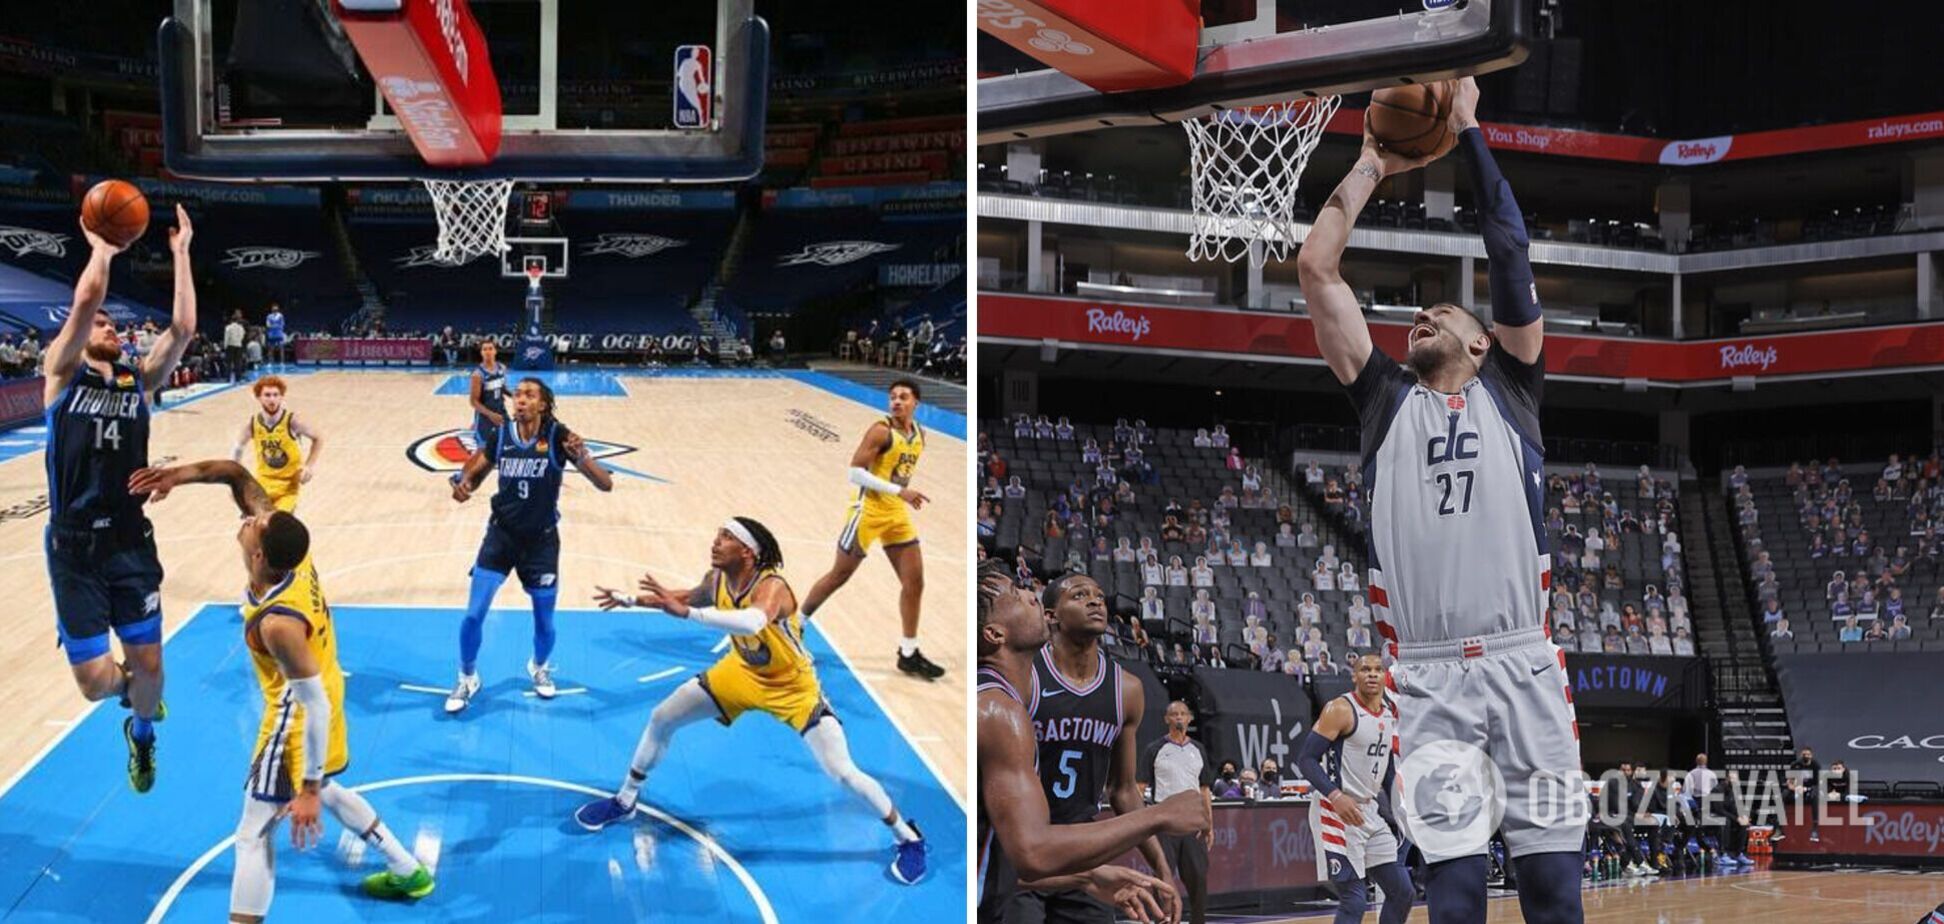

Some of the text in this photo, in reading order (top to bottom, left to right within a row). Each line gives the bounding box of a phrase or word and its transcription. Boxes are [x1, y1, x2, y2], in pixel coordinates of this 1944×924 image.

[679, 109, 697, 123] NBA
[1487, 127, 1550, 149] You Shop
[1868, 120, 1943, 139] raleys.com
[1677, 143, 1716, 160] Raley's
[608, 195, 682, 207] THUNDER
[1086, 308, 1151, 341] Raley's
[1720, 345, 1777, 371] Raley's
[68, 386, 141, 419] THUNDER
[93, 418, 122, 450] 14
[500, 458, 549, 478] THUNDER
[518, 480, 529, 499] 9
[1436, 470, 1475, 516] 27
[1576, 664, 1669, 698] ACTOWN
[1033, 716, 1119, 748] SACTOWN
[1052, 750, 1083, 799] 5
[1371, 761, 1379, 780] 4
